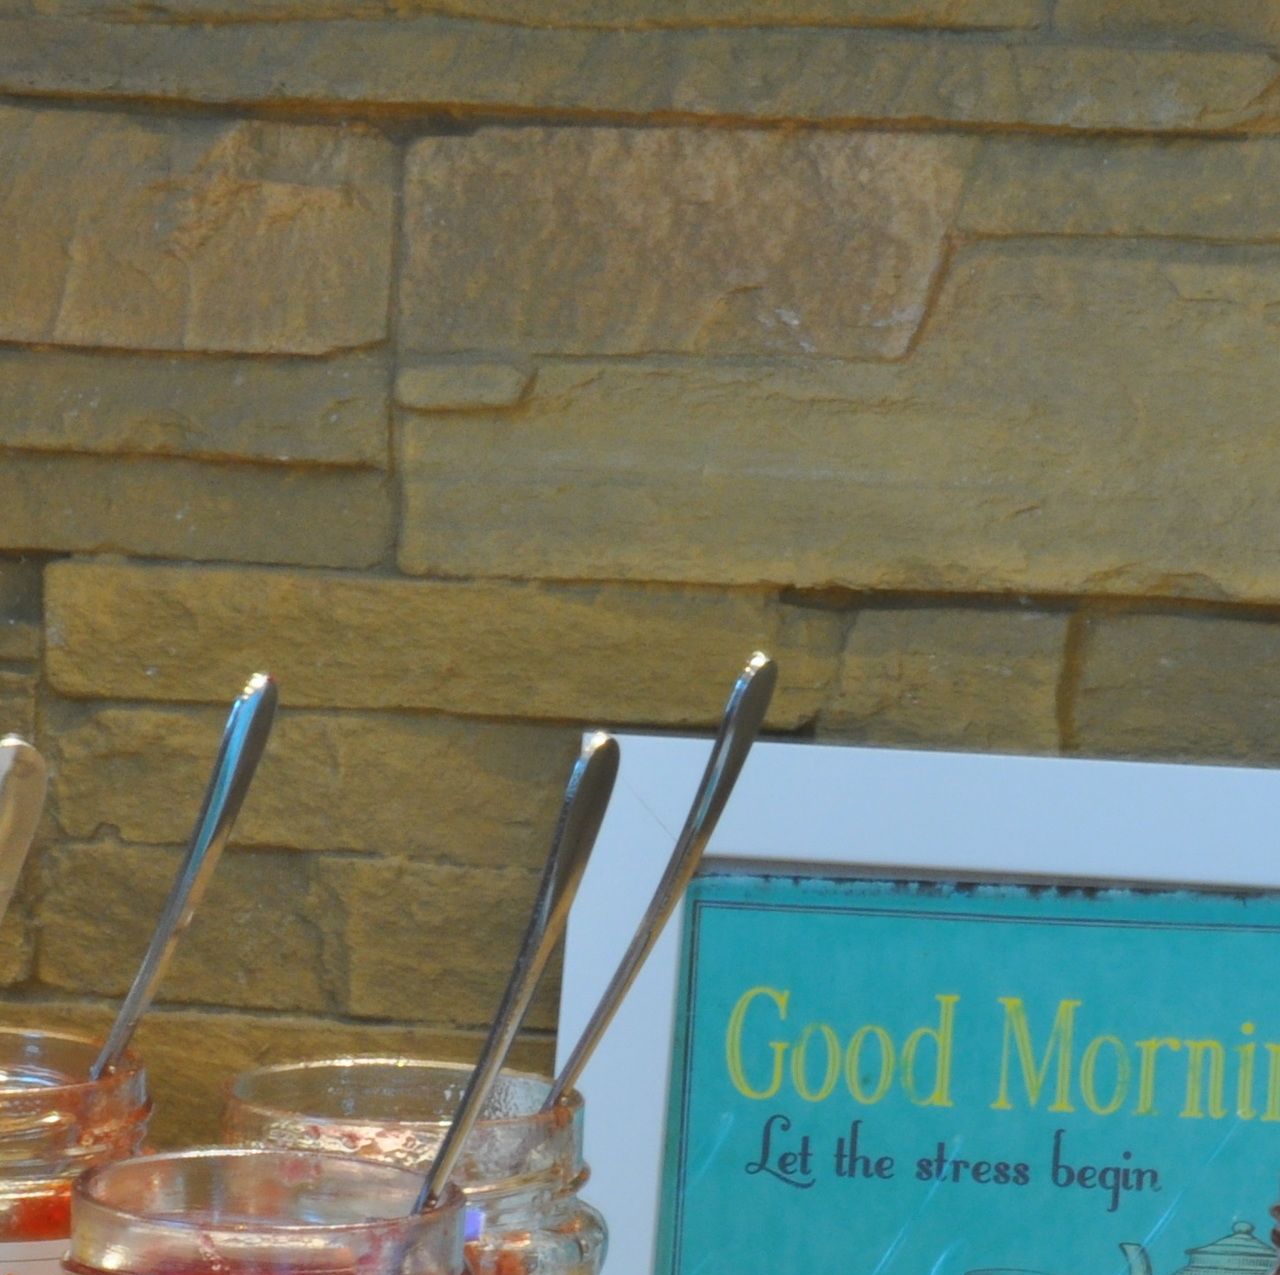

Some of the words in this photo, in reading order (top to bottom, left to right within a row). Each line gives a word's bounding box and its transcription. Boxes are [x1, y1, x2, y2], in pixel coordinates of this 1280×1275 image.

[725, 986, 960, 1108] Good
[744, 1114, 817, 1190] Let
[833, 1119, 896, 1181] the
[916, 1142, 1031, 1188] stress
[1051, 1128, 1163, 1212] begin
